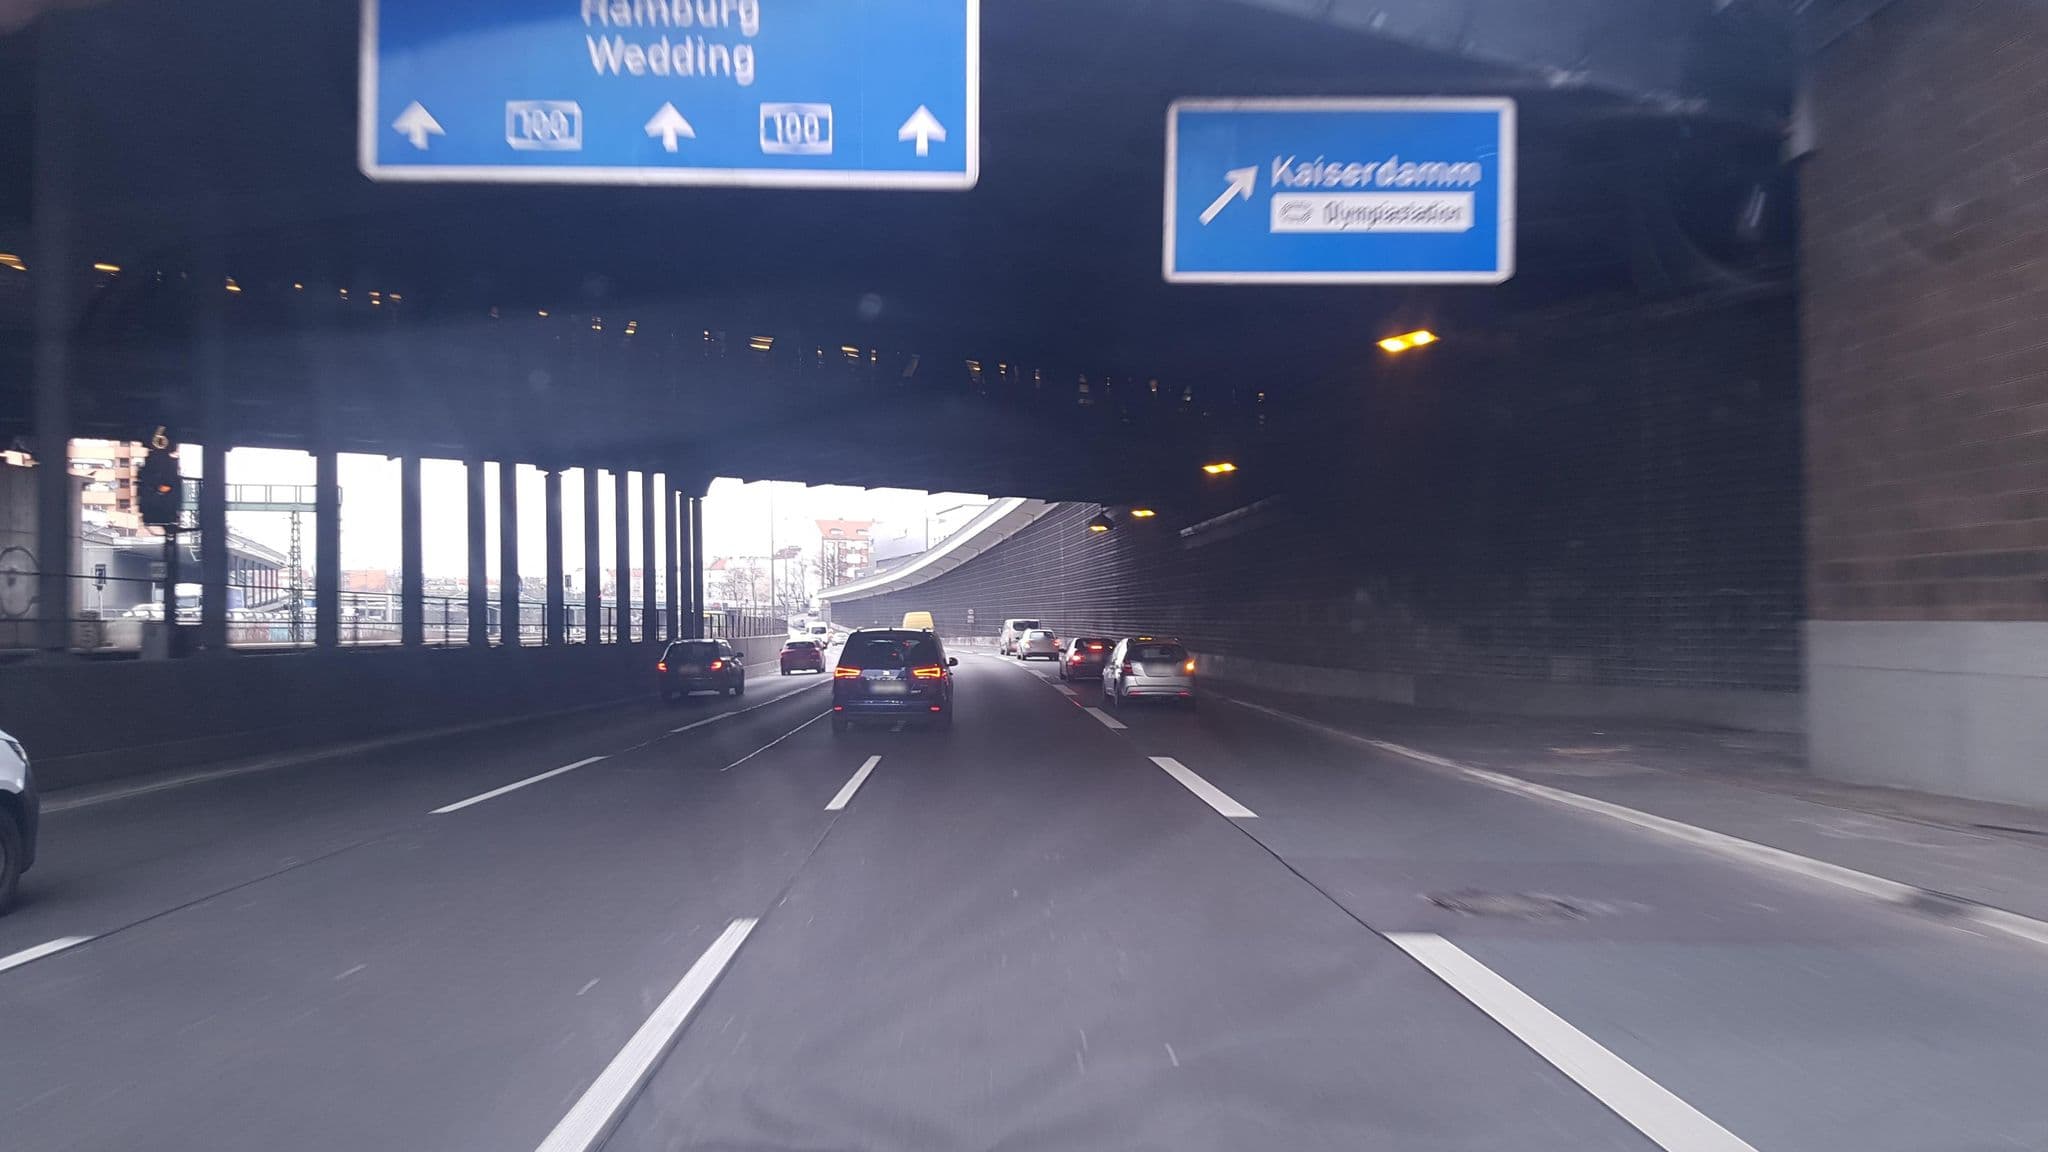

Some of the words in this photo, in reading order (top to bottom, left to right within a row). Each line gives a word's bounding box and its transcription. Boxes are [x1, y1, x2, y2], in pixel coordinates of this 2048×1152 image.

[581, 0, 759, 37] Hamburg
[586, 34, 755, 86] Wedding
[522, 110, 568, 140] 100
[774, 112, 819, 144] 100
[1271, 154, 1482, 188] Kaiserdamm
